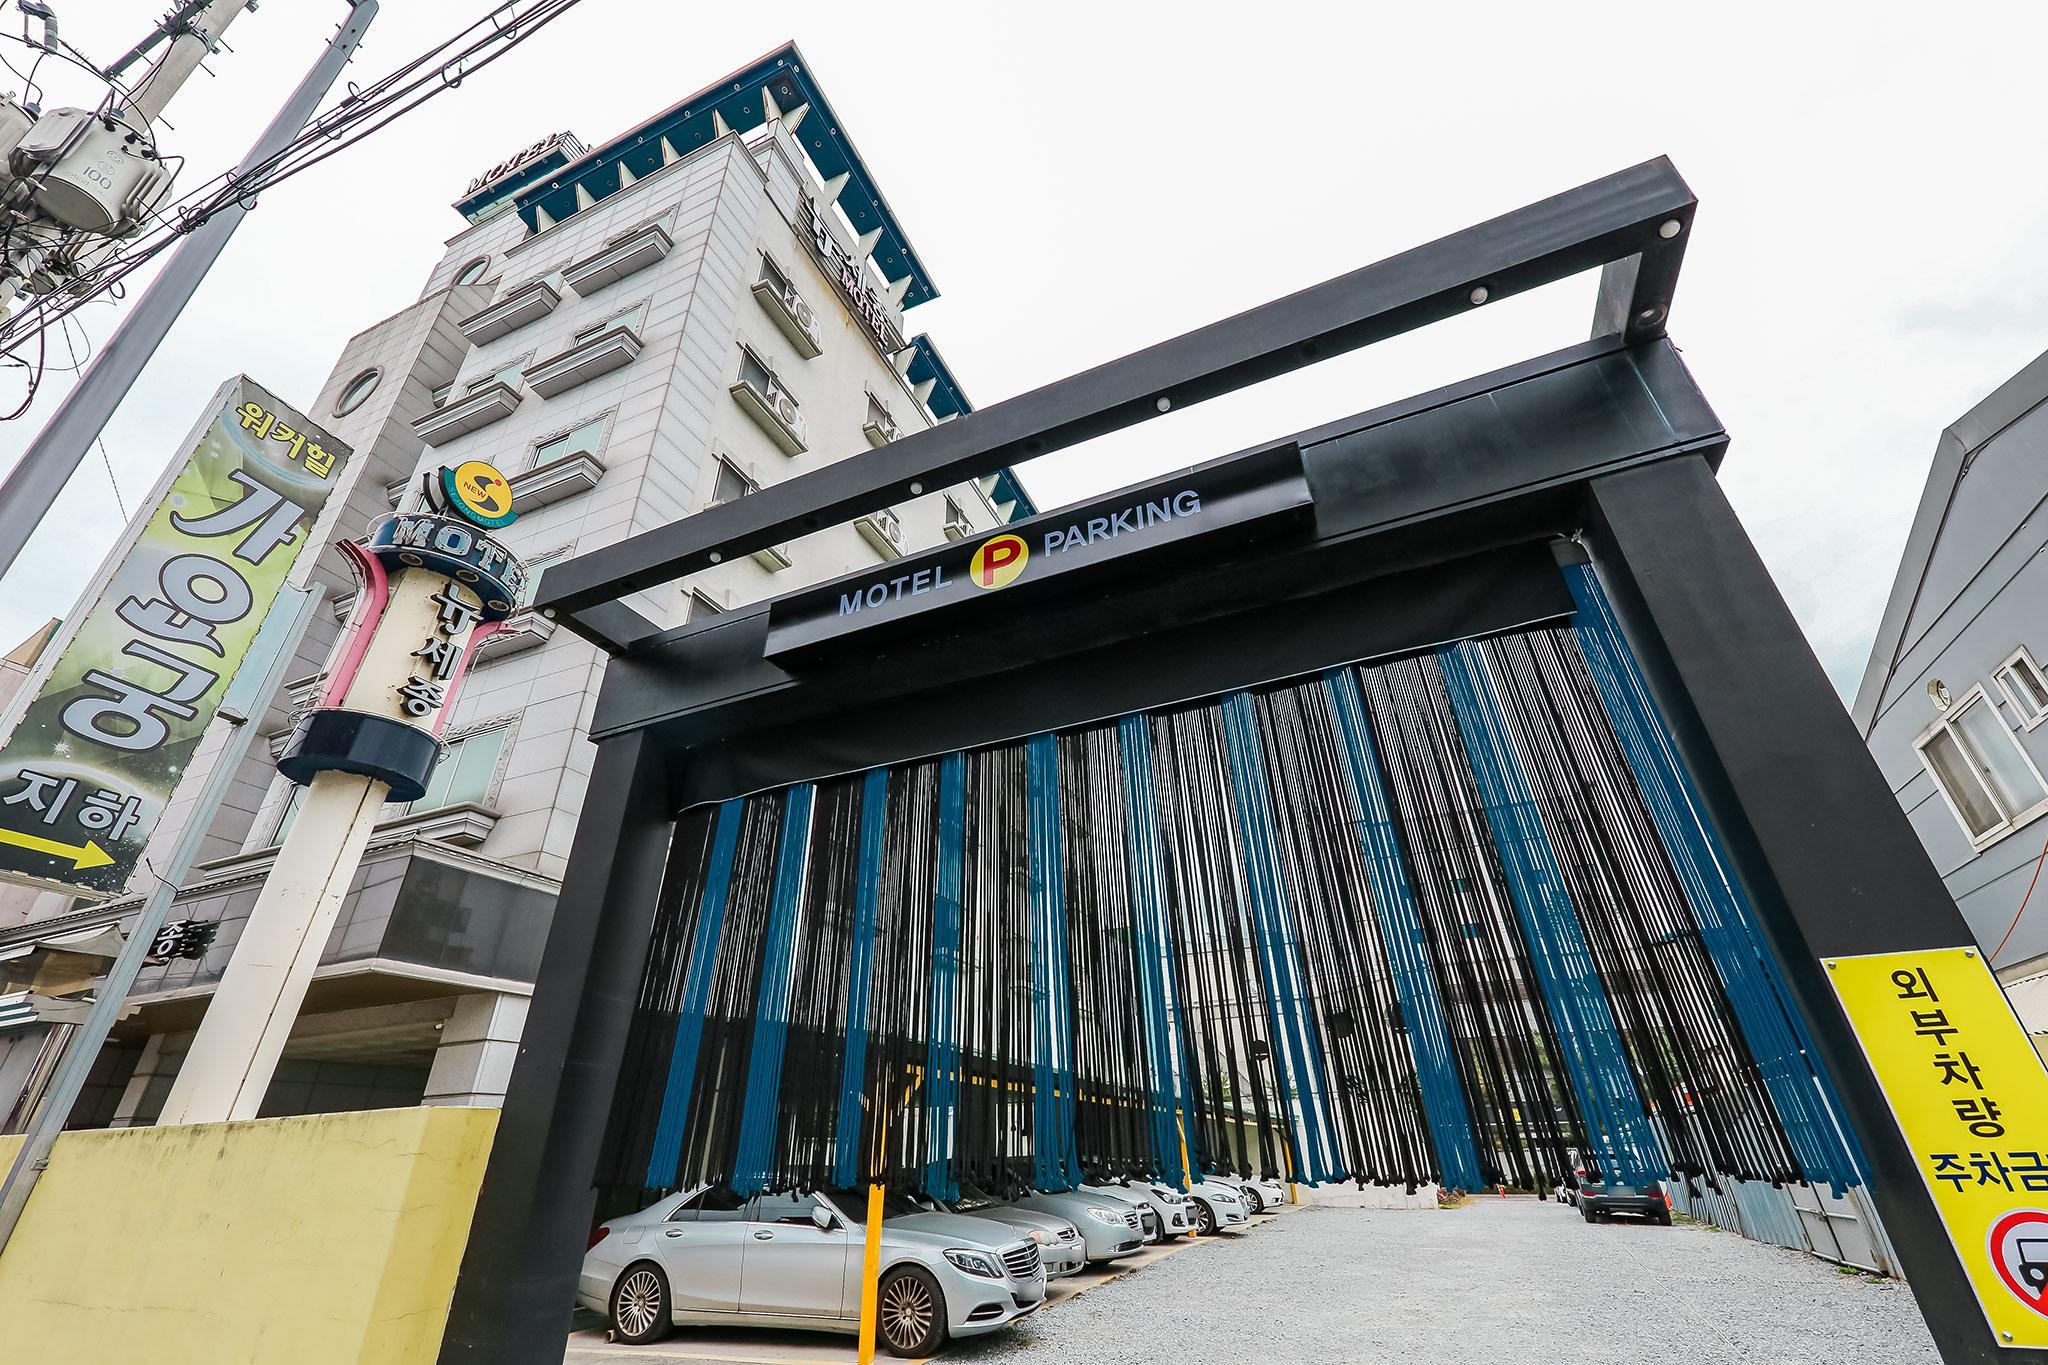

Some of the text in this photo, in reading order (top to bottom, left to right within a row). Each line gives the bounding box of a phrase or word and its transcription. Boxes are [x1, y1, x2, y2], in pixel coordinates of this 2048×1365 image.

[83, 166, 112, 190] 100
[841, 268, 890, 349] MOTEL
[236, 401, 336, 480] 워커힐
[463, 481, 487, 499] NEW
[838, 566, 953, 618] MOTEL
[1044, 489, 1202, 558] PARKING
[58, 468, 305, 752] 가요궁
[406, 583, 484, 717] 뉴세종
[1, 768, 144, 843] 지하
[1929, 1150, 2048, 1194] 주차금
